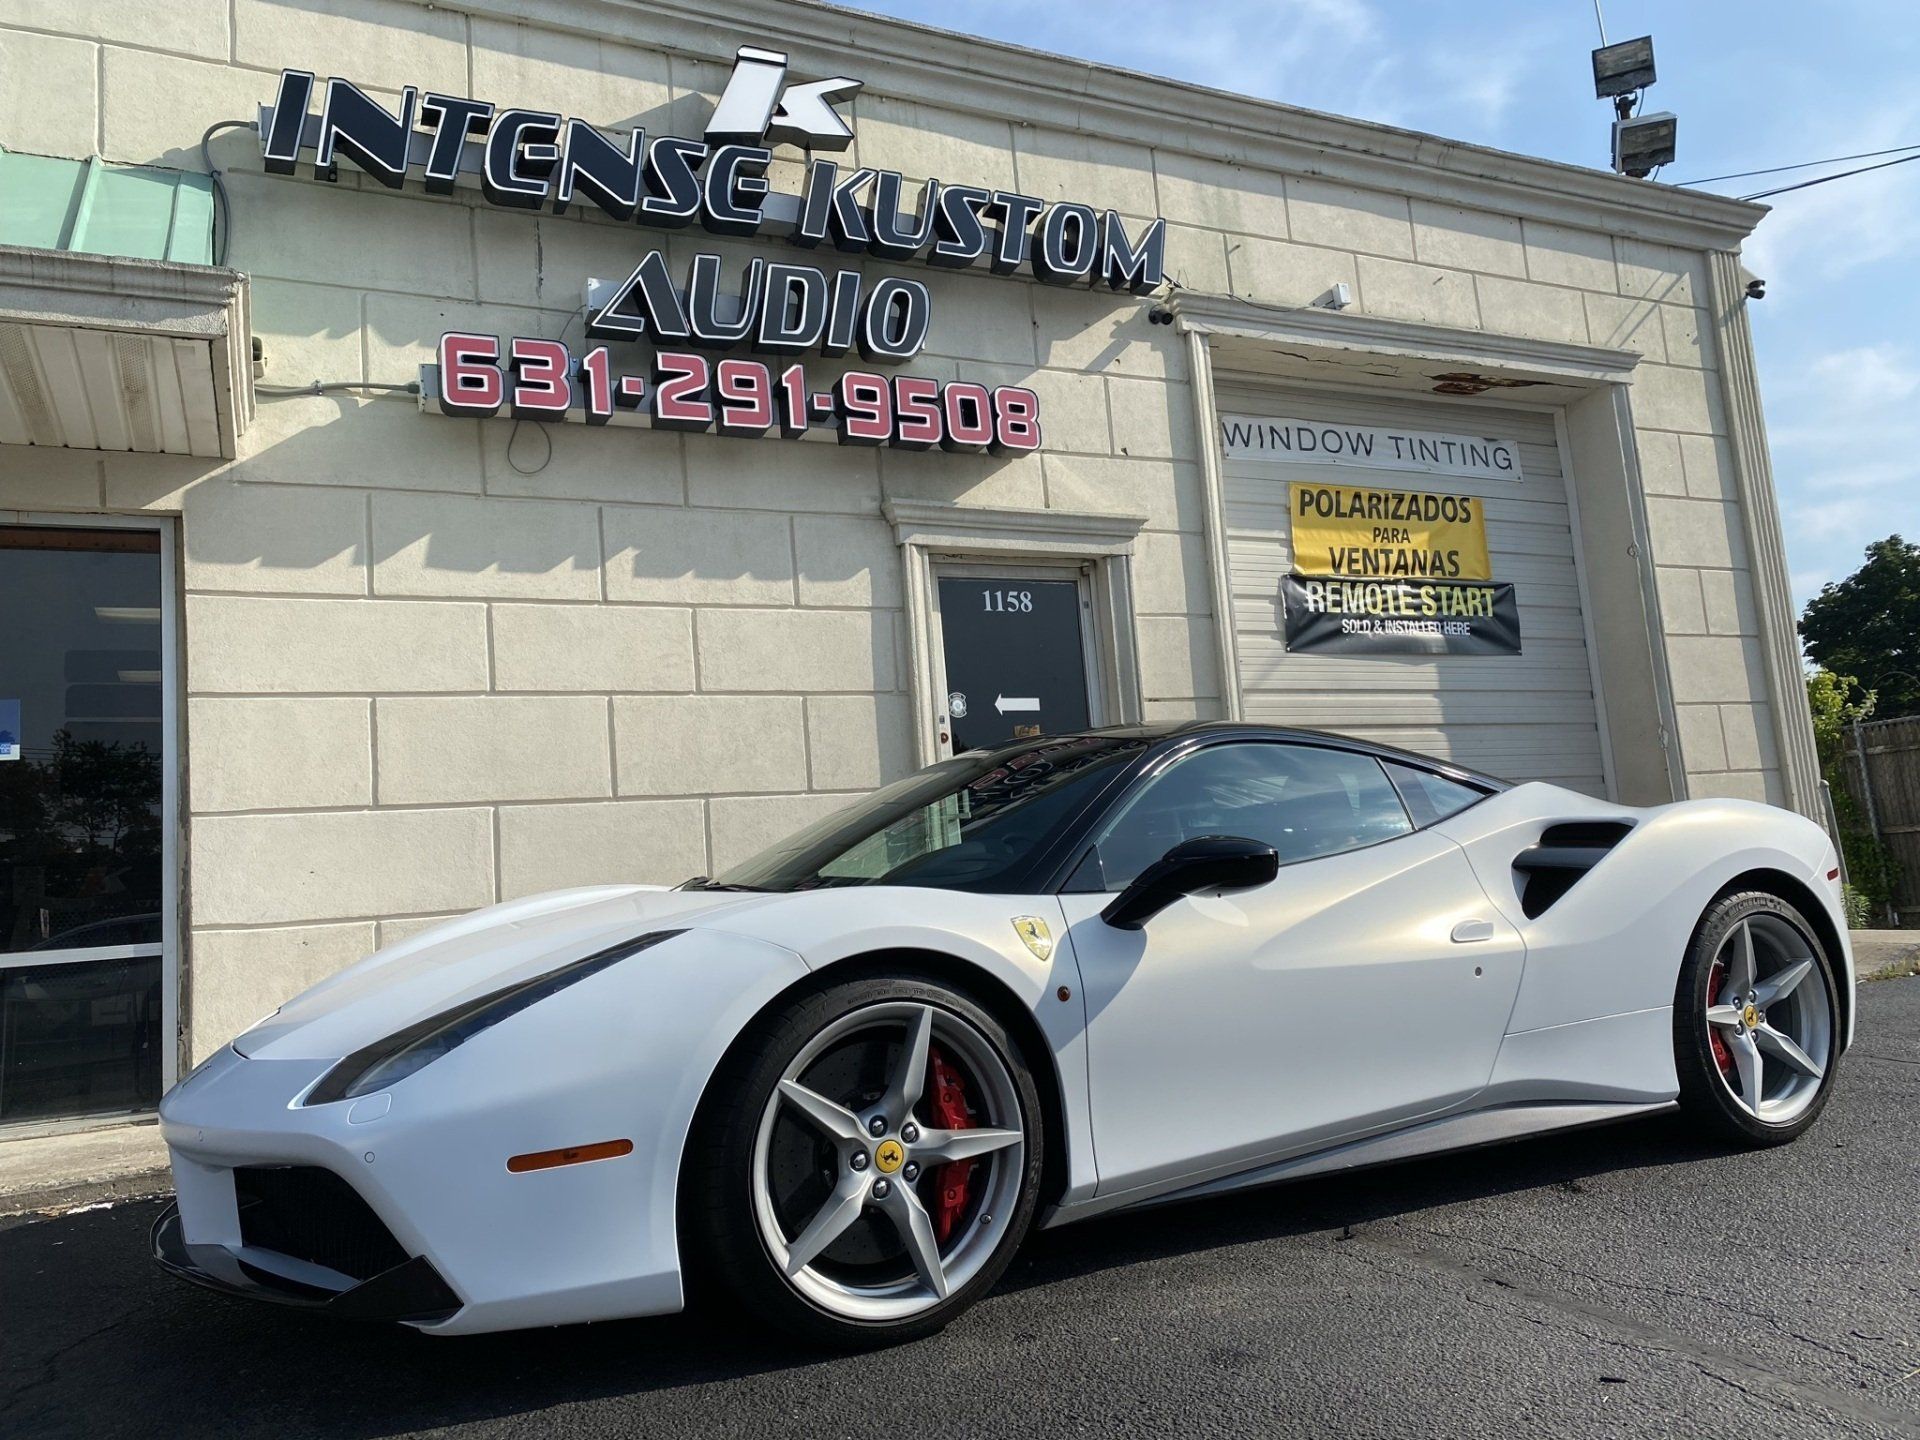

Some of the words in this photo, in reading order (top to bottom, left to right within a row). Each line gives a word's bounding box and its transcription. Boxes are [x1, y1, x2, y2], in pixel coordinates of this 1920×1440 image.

[264, 67, 772, 230] INTENSE
[800, 159, 1167, 290] KUSTOM
[590, 249, 932, 359] AUDIO
[438, 331, 1042, 449] 631-291-9508
[1221, 422, 1374, 457] WINDOW
[1387, 435, 1513, 471] TINTING
[1299, 488, 1472, 524] POLARIZADOS
[1372, 526, 1411, 544] PARA
[1328, 546, 1460, 578] VENTANAS
[982, 590, 1033, 613] 1158
[1305, 580, 1415, 616] REMOTE
[1420, 586, 1495, 617] START
[1341, 618, 1371, 635] SOLD
[1373, 620, 1384, 635] &
[1385, 620, 1442, 636] INSTALLED
[1443, 621, 1471, 636] HERE
